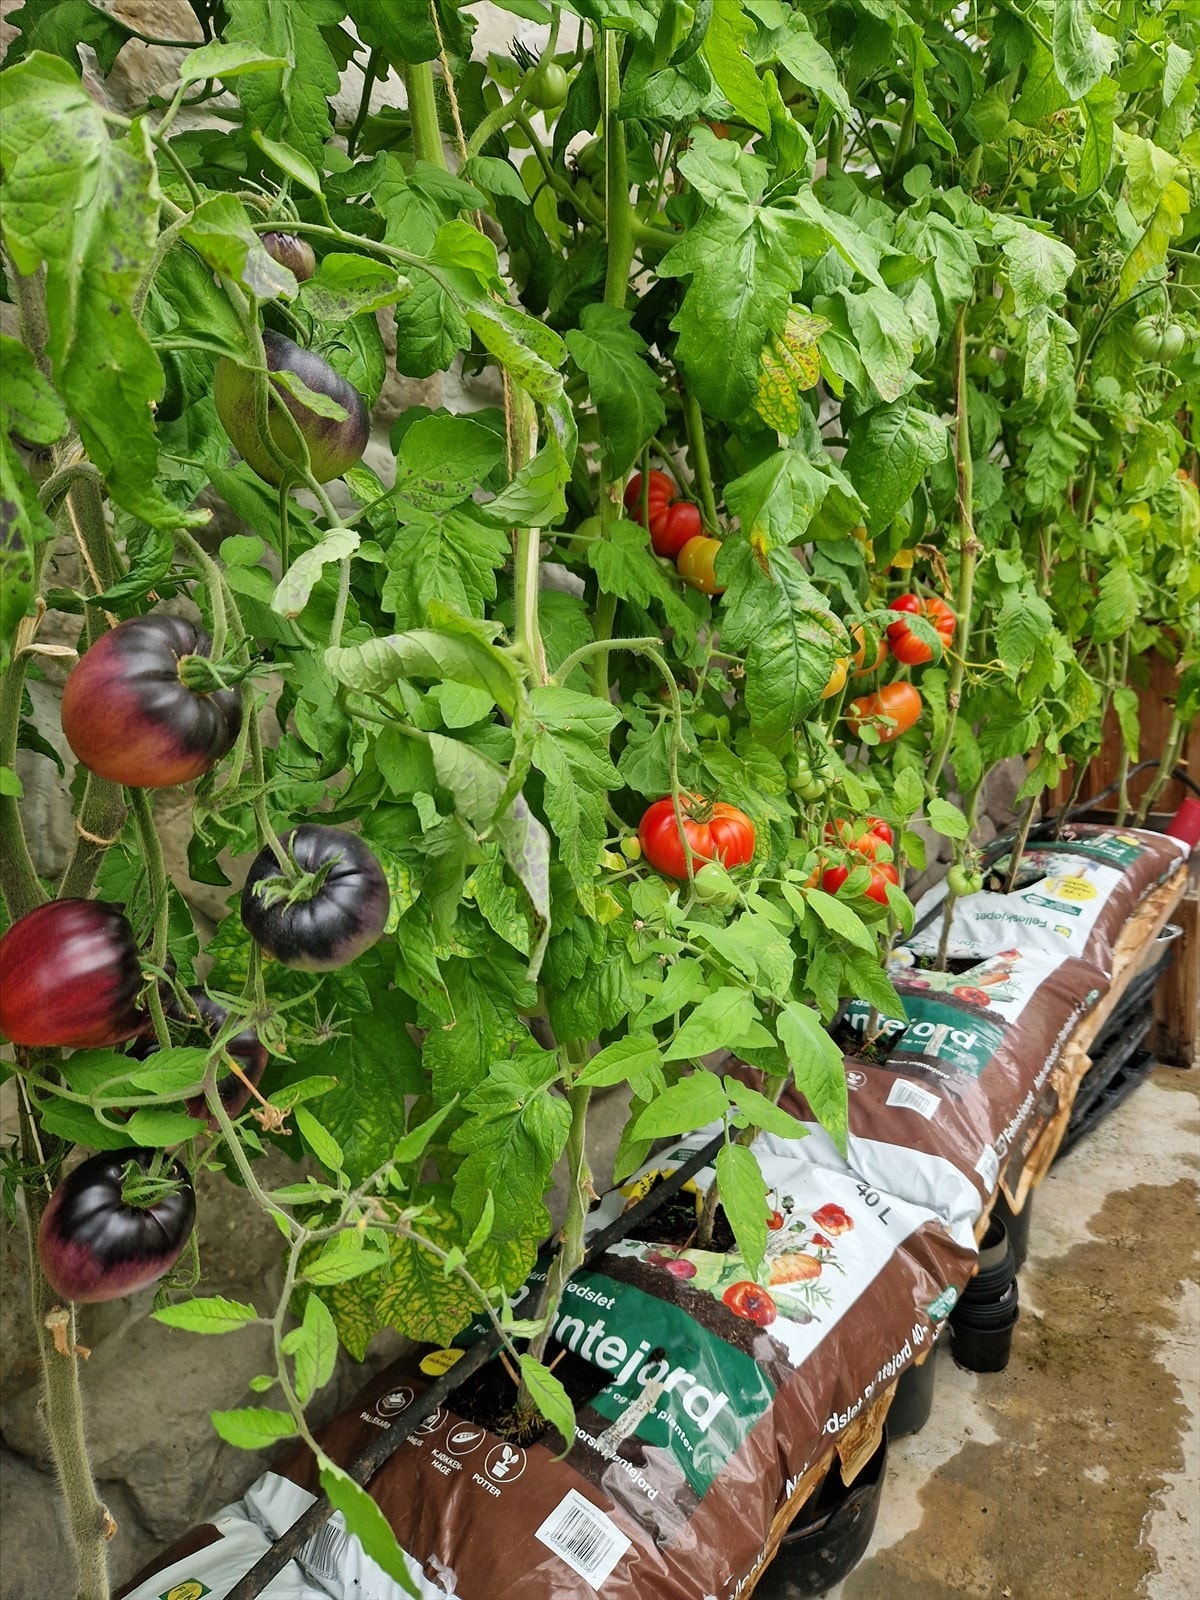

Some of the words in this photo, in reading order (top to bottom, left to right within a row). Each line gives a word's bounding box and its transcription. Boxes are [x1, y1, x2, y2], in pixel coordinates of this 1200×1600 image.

[854, 1182, 881, 1209] 40
[876, 1206, 893, 1227] L
[657, 1408, 694, 1452] planter
[431, 1459, 452, 1477] HAGE
[472, 1472, 502, 1498] POTTER
